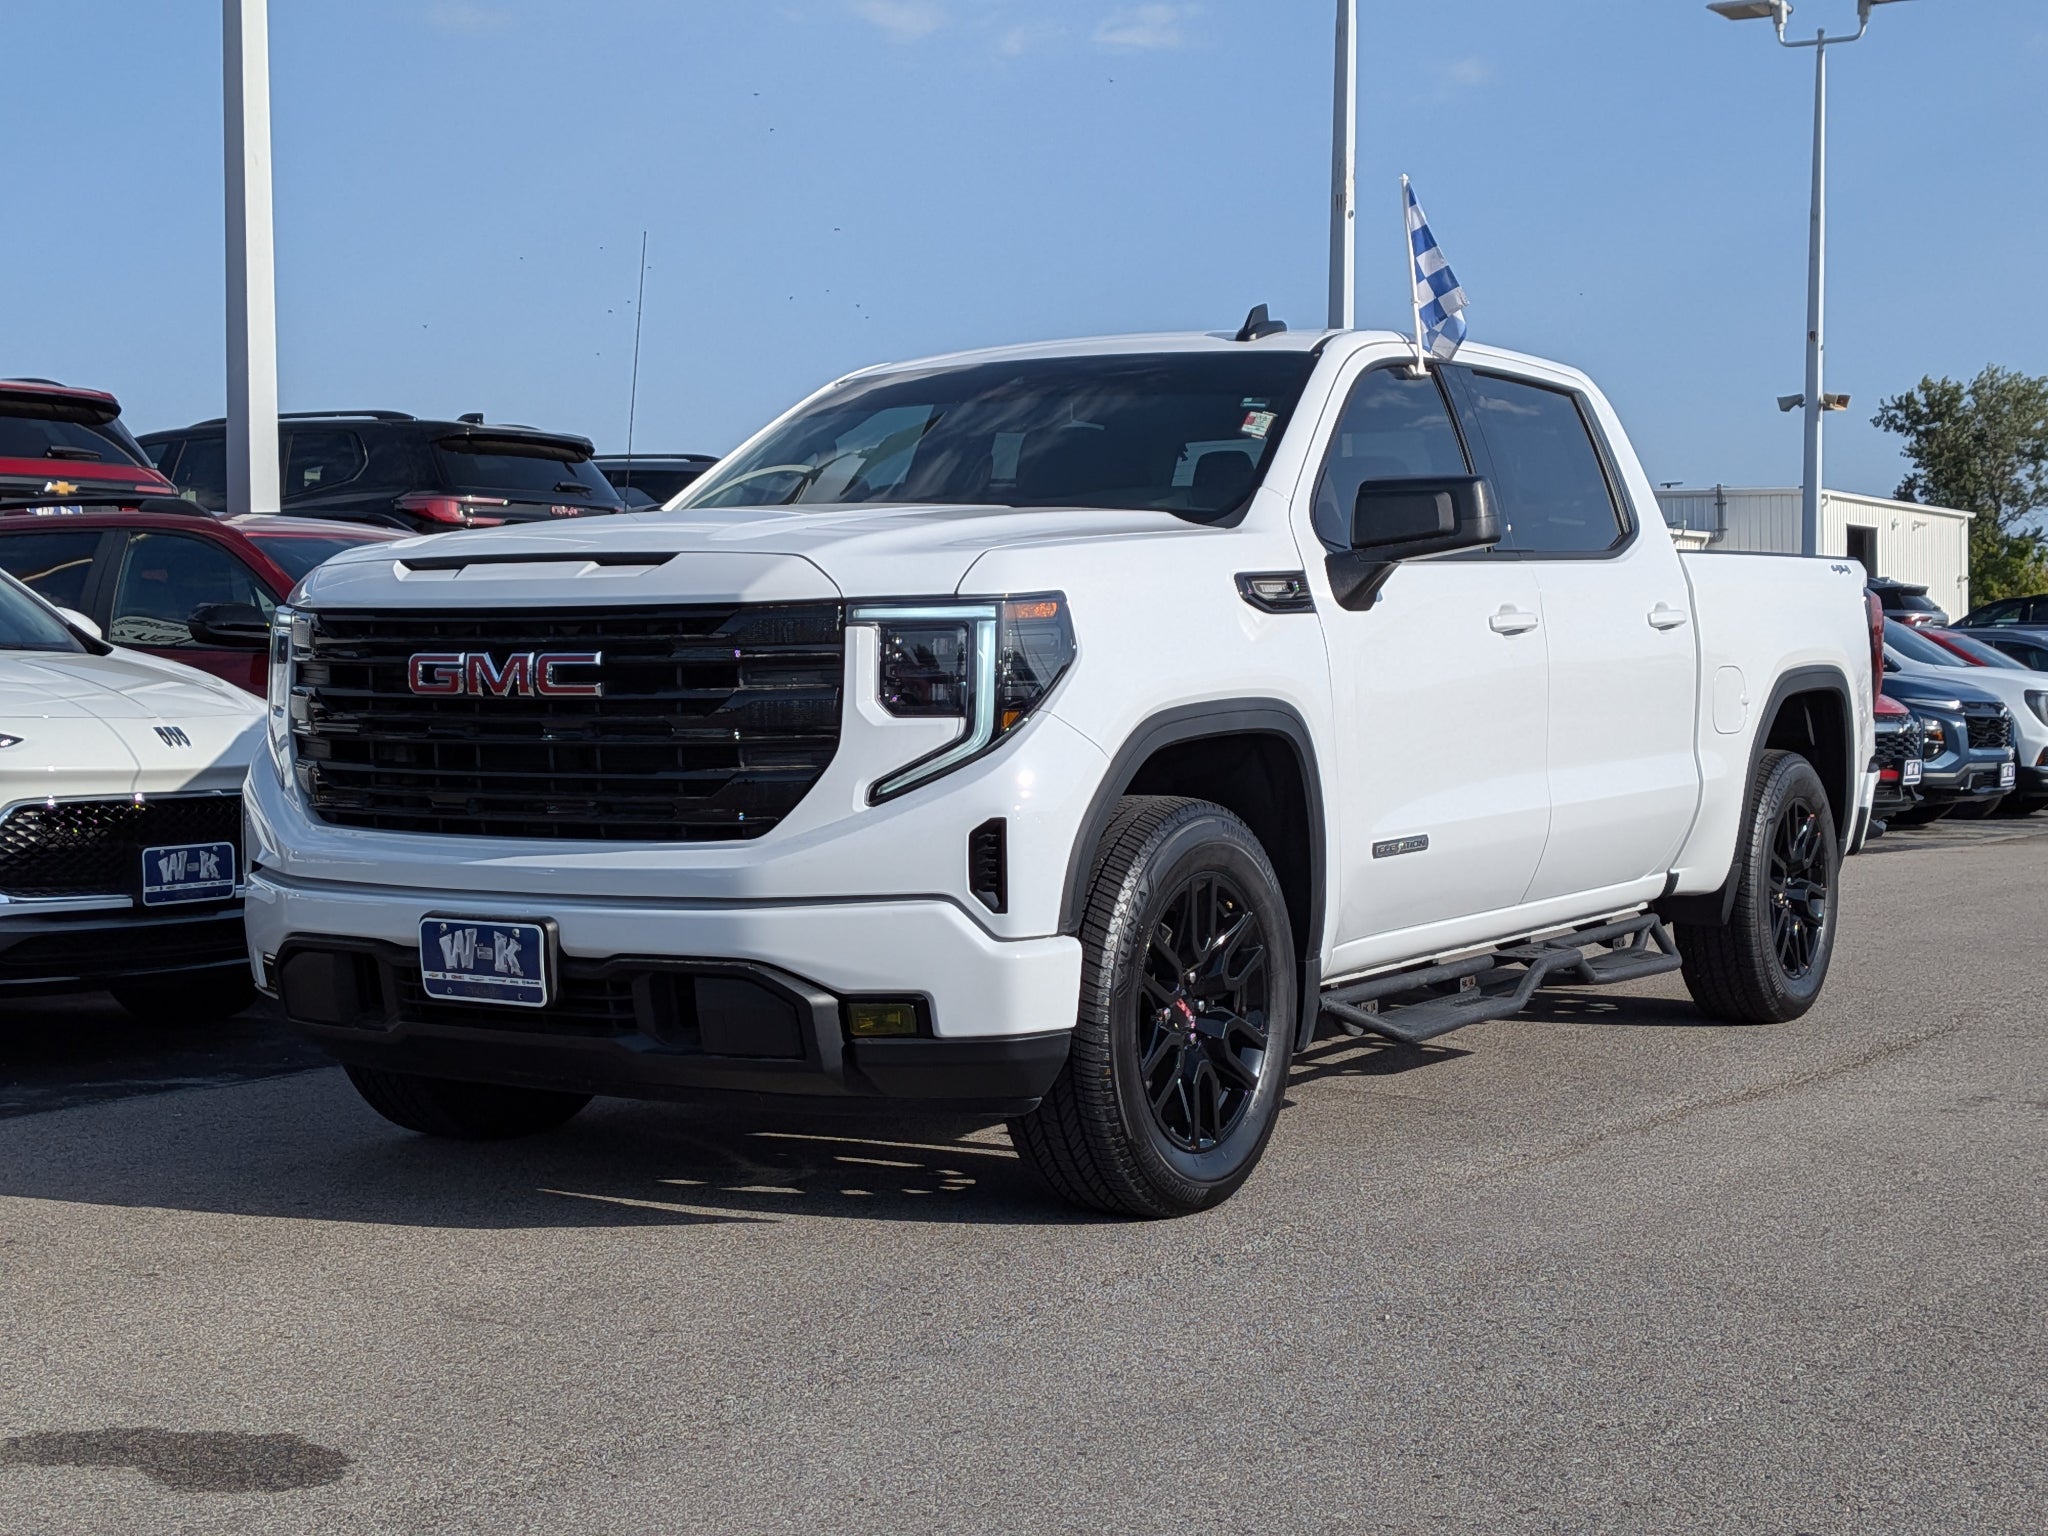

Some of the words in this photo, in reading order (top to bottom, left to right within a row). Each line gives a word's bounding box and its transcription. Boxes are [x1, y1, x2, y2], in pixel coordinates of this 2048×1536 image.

[408, 651, 604, 697] GMC
[157, 850, 221, 883] W-K
[438, 928, 524, 977] W-K
